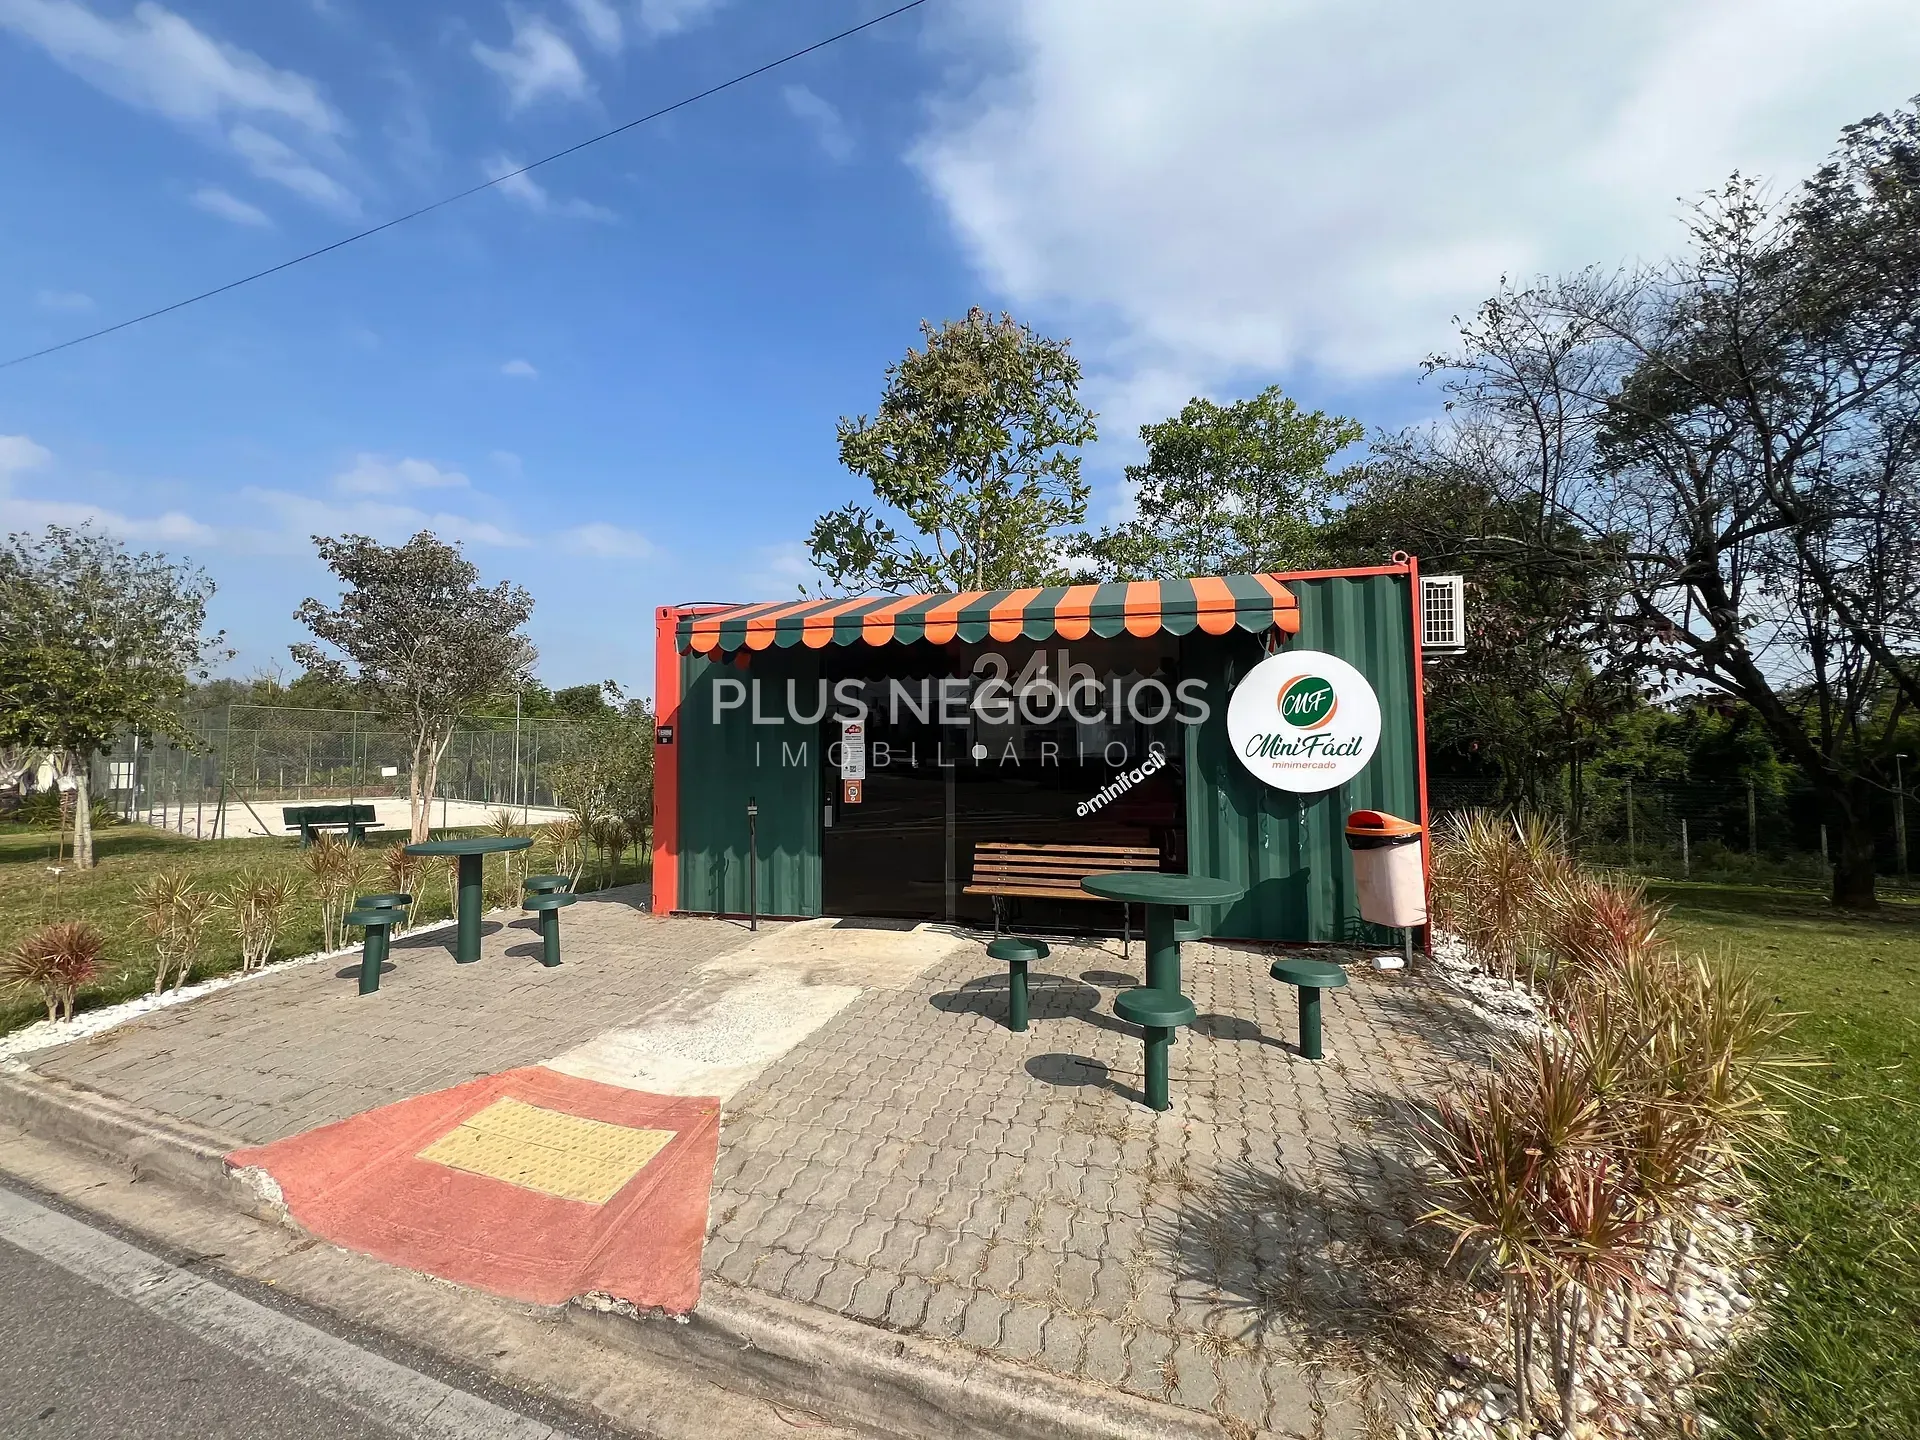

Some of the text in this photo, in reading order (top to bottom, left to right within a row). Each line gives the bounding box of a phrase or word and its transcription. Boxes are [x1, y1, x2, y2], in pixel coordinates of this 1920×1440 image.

[970, 648, 1096, 708] 24h
[1076, 750, 1166, 817] @minifacil
[1271, 760, 1337, 770] minimercado
